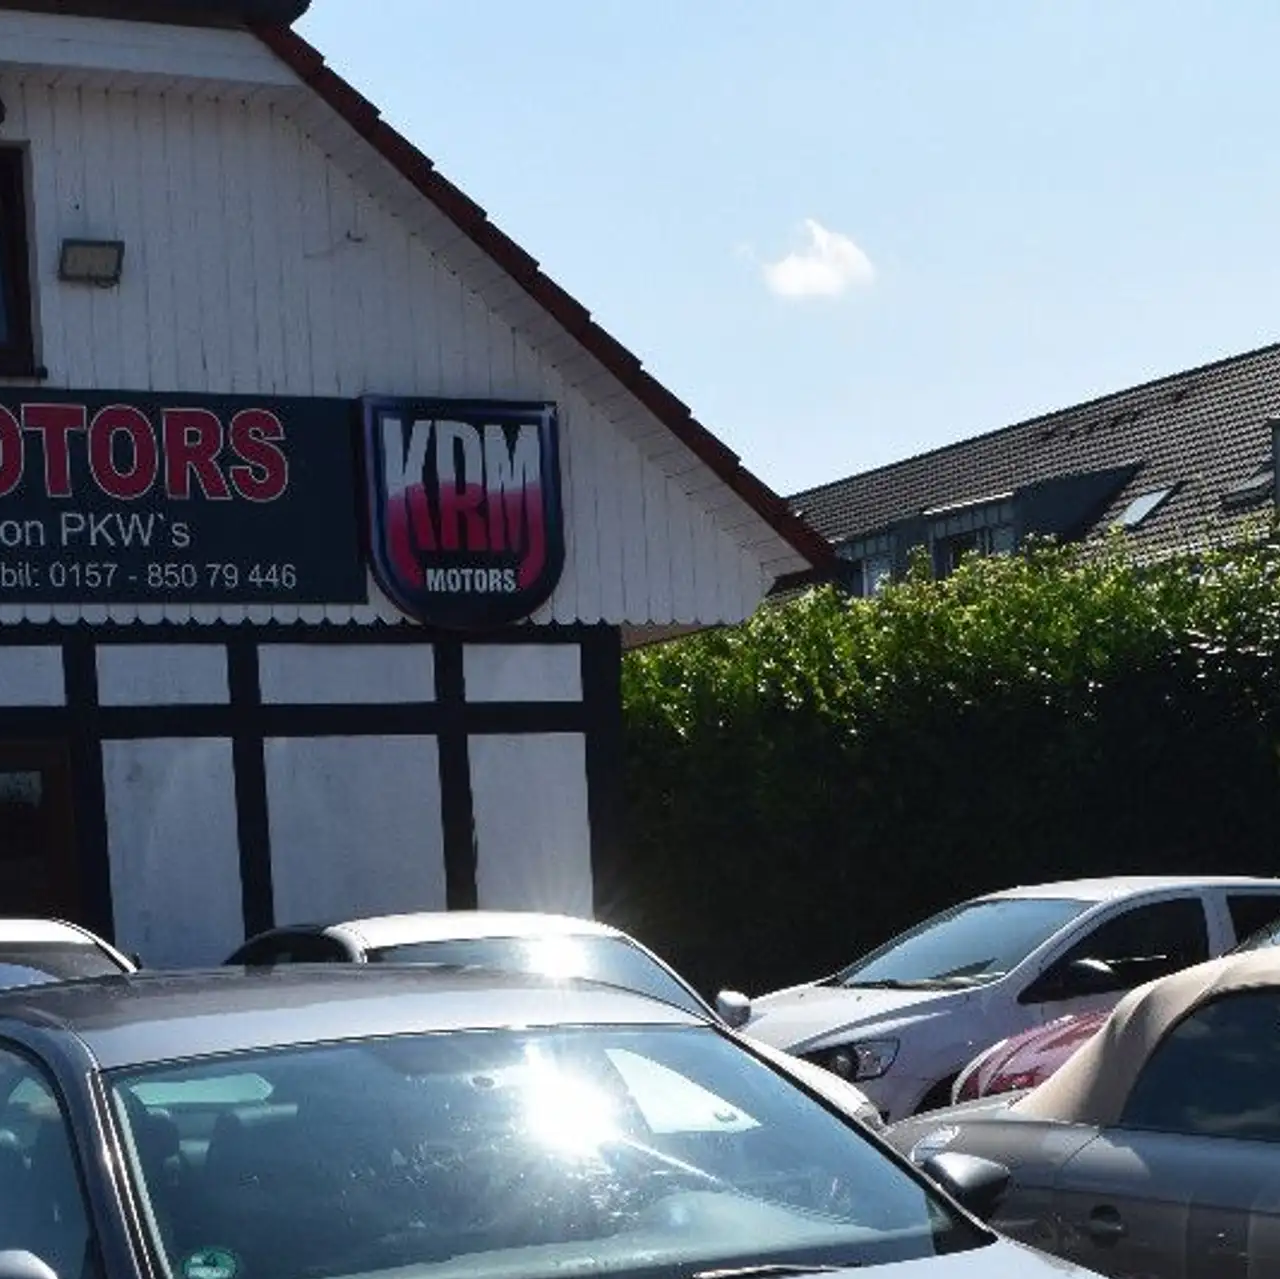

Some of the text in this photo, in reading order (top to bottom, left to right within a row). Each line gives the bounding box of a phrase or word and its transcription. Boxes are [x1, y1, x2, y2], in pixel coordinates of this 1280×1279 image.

[382, 418, 544, 553] KRM
[48, 563, 118, 589] 0157
[147, 563, 197, 589] 850
[206, 563, 239, 589] 79
[248, 563, 297, 590] 446
[426, 567, 517, 593] MOTORS
